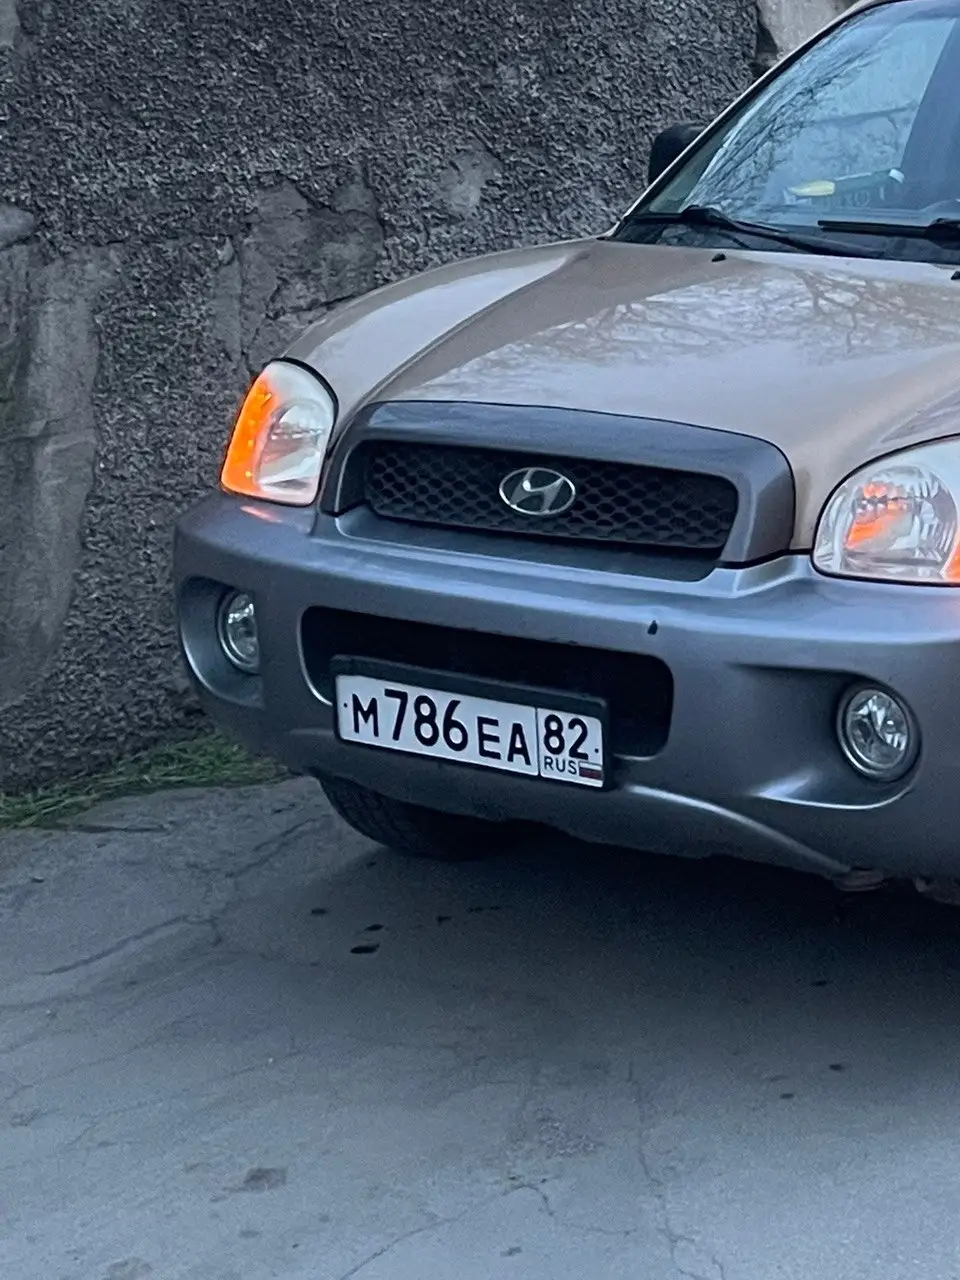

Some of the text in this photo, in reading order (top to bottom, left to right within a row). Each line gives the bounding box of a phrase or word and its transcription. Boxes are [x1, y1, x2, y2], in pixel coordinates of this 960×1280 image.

[352, 688, 589, 766] М786ЕА 82
[544, 755, 577, 775] RUS
